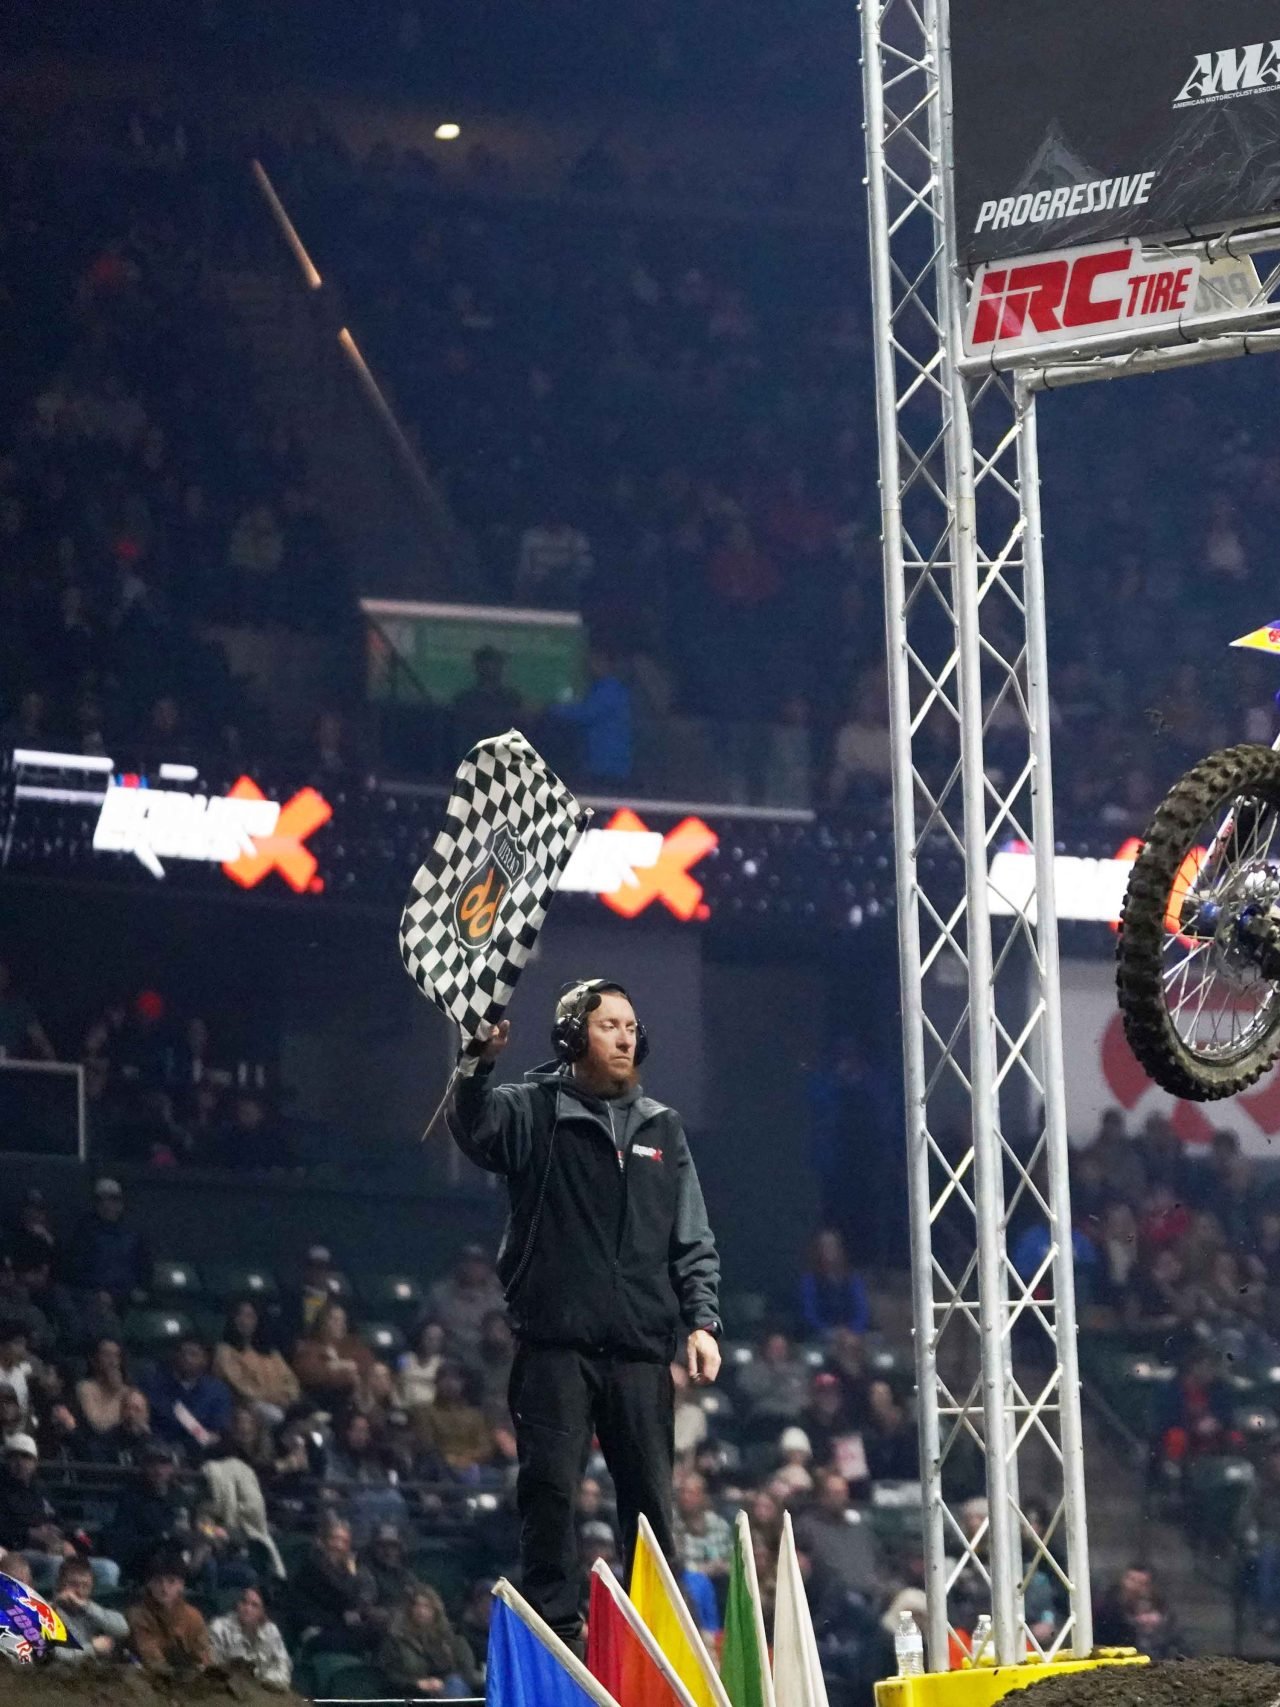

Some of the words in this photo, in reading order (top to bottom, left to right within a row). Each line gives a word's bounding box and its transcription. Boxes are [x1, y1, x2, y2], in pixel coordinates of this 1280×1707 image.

[1172, 97, 1205, 109] AMERICAN
[1205, 89, 1252, 104] MOTORCYCLIST
[974, 171, 1156, 234] PROGRESSIVE
[971, 248, 1134, 345] IRC
[1126, 267, 1193, 318] TIRE
